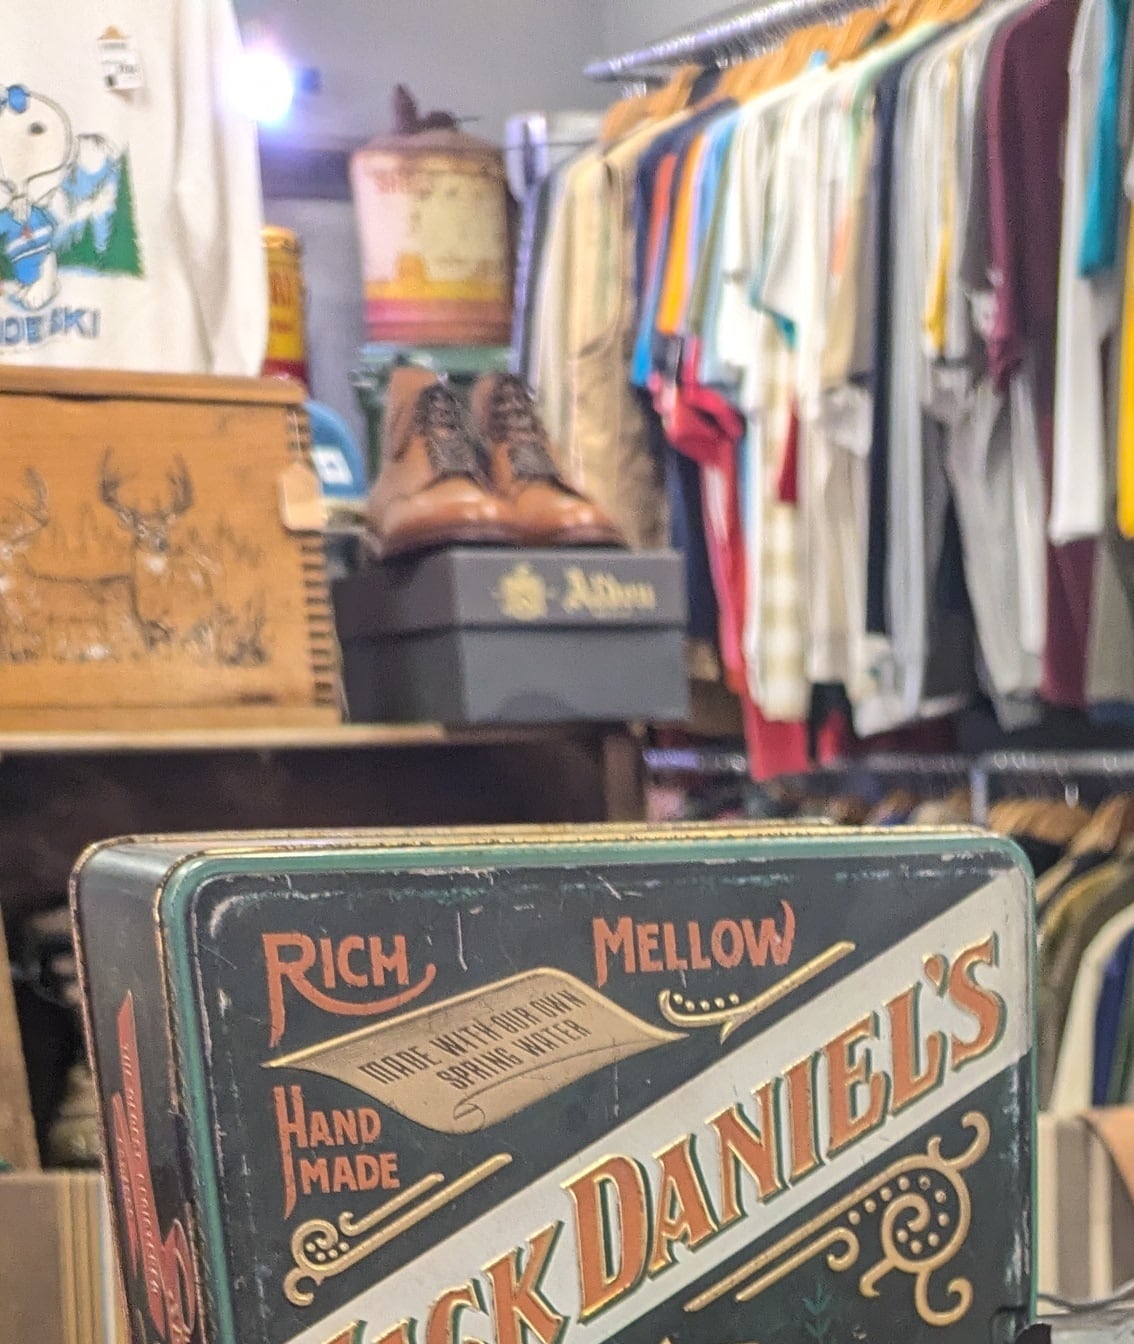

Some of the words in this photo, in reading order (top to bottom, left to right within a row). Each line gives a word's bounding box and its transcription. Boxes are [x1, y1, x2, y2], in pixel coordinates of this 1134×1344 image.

[262, 931, 437, 1048] RICH
[592, 899, 796, 988] MELLOW
[358, 1046, 443, 1086] MADE
[429, 1017, 504, 1058] WITH
[490, 1006, 541, 1044] OUR
[529, 989, 587, 1018] OWN
[436, 1047, 524, 1091] SPRING
[512, 1018, 592, 1058] WATER
[274, 1084, 382, 1219] HAND
[299, 1153, 400, 1195] MADE
[560, 931, 1007, 1325] DANIEL'S
